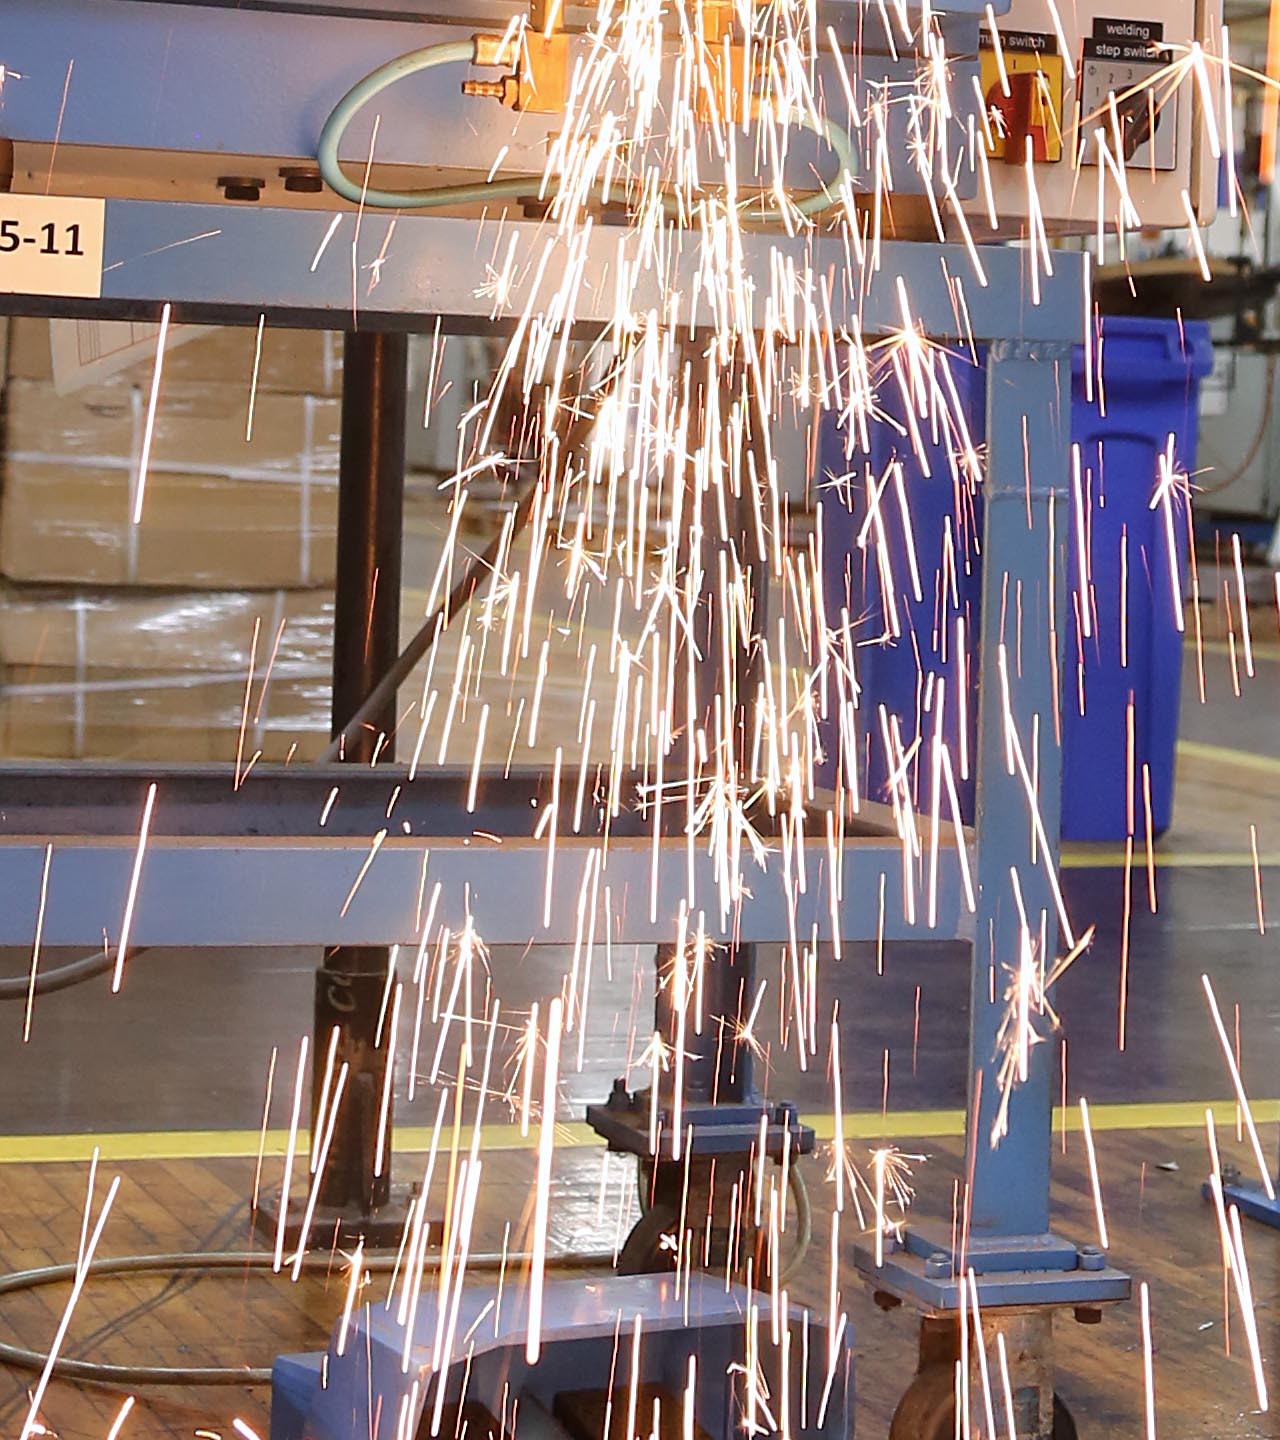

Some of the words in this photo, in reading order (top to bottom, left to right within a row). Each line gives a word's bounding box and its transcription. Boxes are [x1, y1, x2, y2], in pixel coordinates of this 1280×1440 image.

[1106, 23, 1150, 40] welding
[979, 33, 1006, 46] mn
[1009, 35, 1046, 49] switch
[1095, 43, 1121, 58] step
